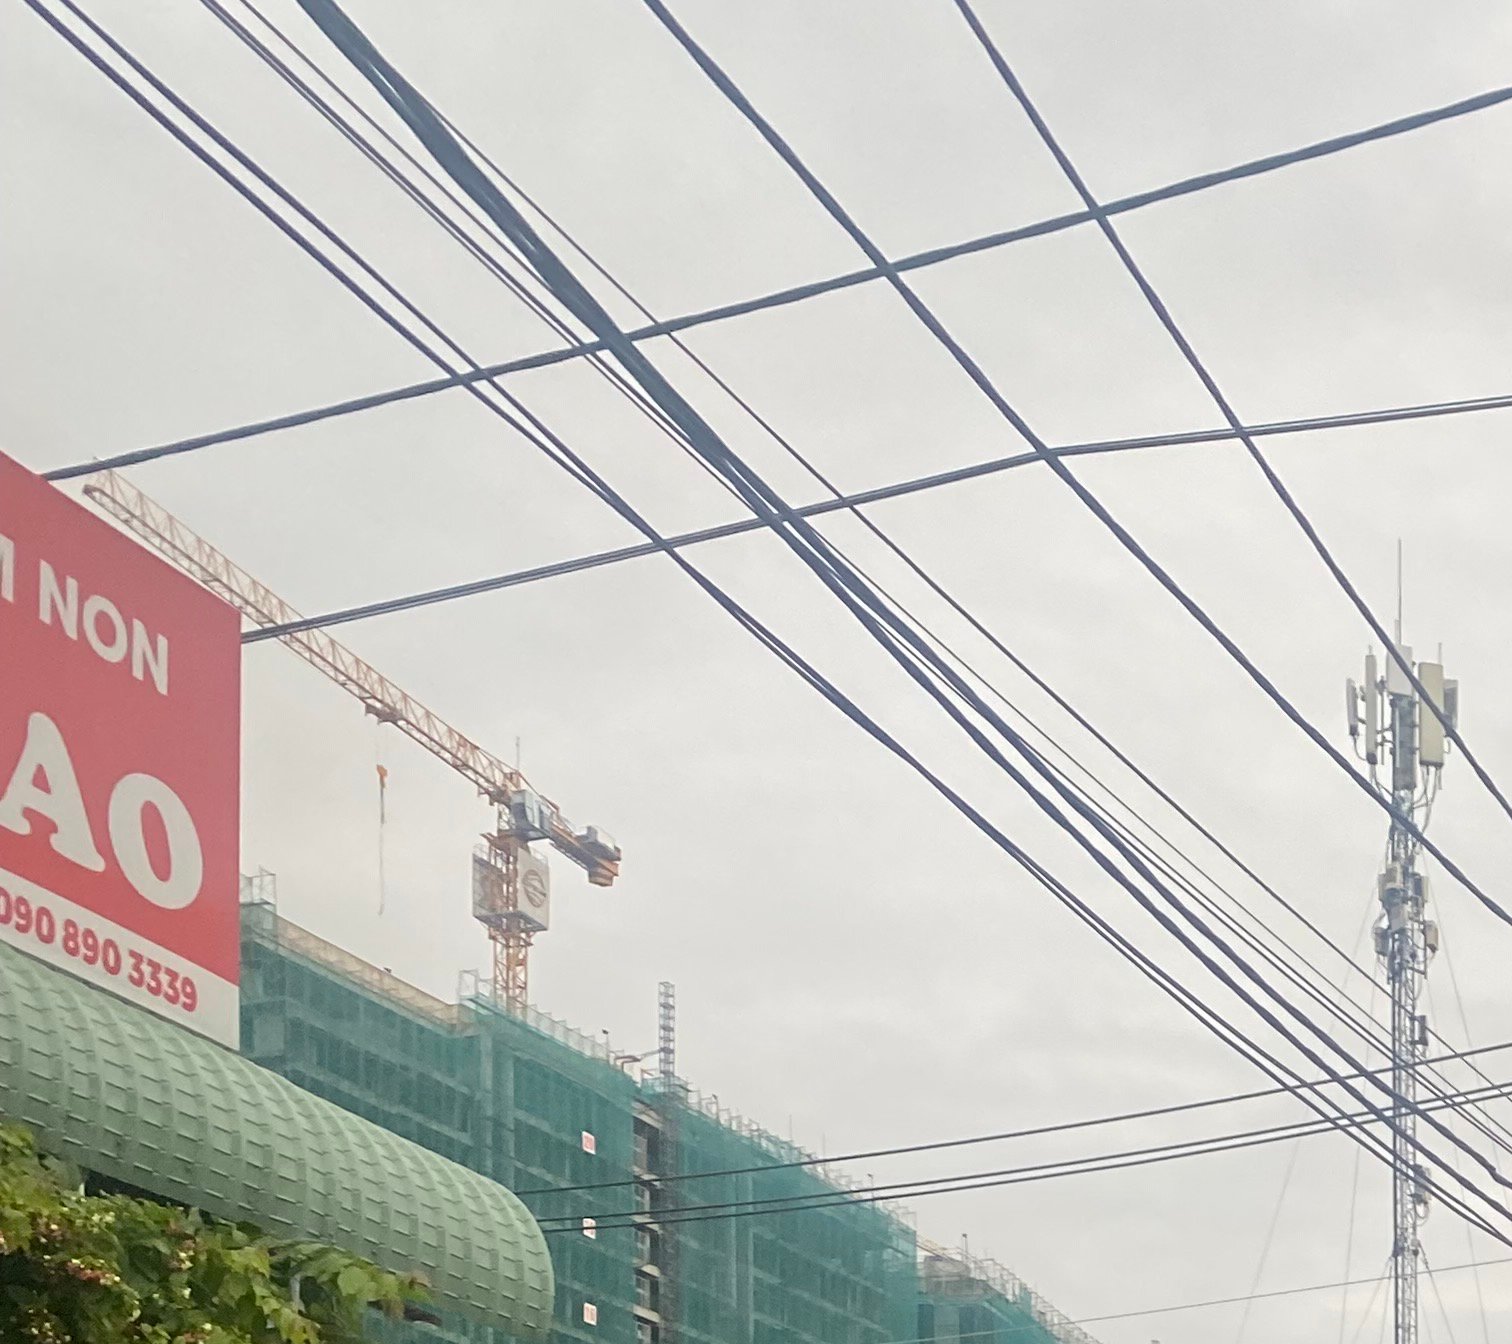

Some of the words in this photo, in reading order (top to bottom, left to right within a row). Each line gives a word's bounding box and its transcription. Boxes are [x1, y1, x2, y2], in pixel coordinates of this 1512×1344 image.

[39, 559, 169, 696] NON
[62, 918, 122, 976] 890
[128, 950, 198, 1013] 3339
